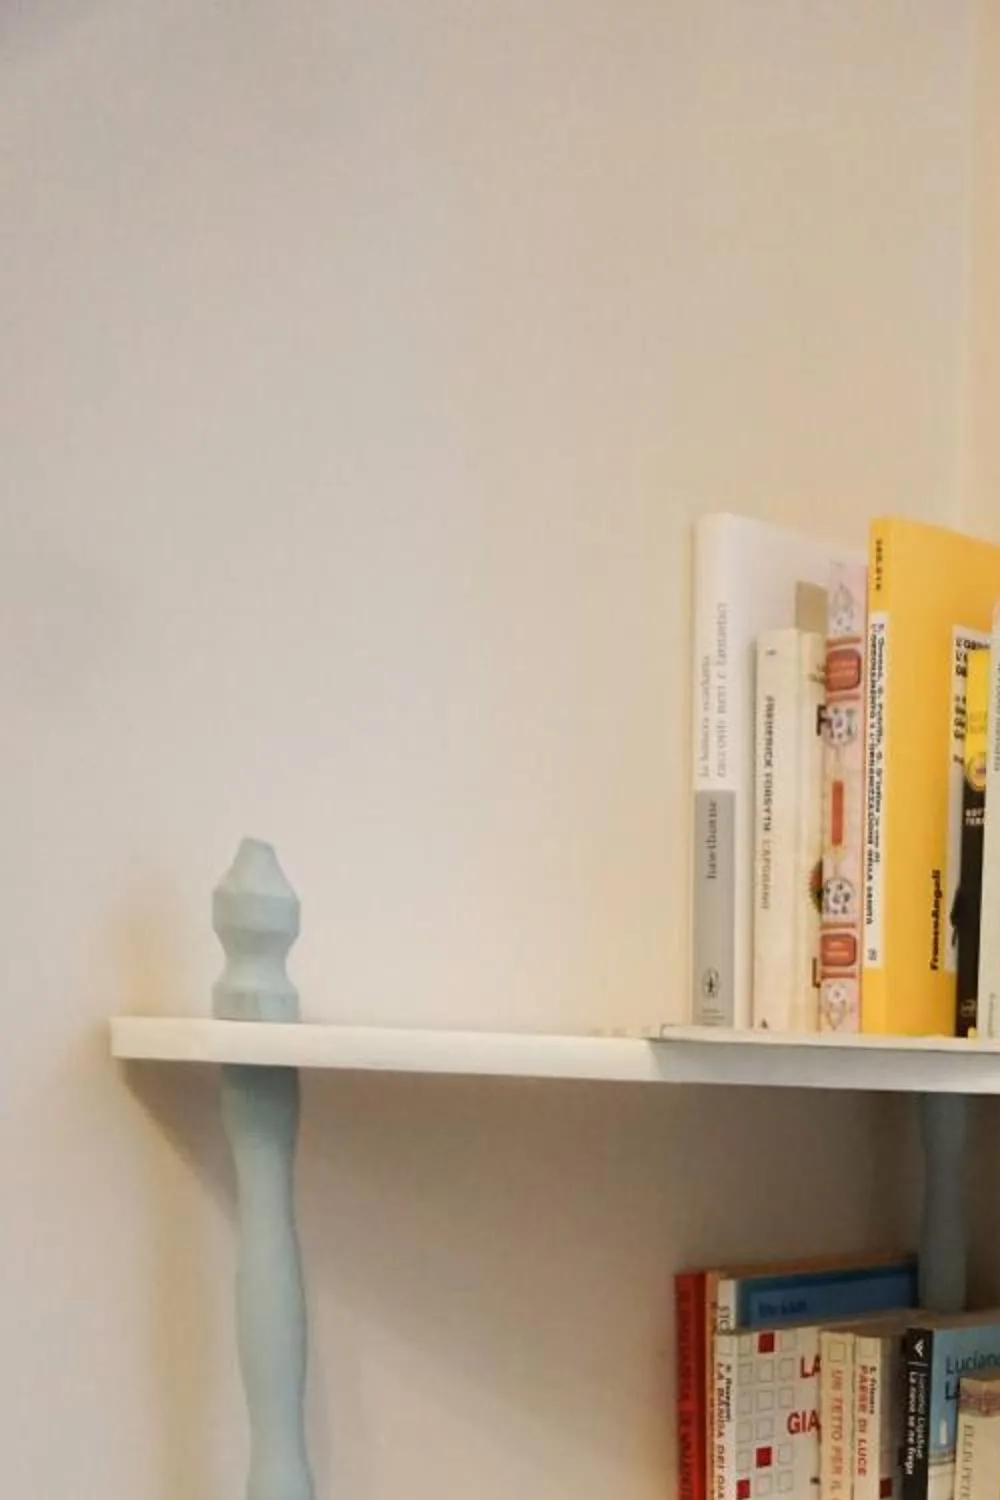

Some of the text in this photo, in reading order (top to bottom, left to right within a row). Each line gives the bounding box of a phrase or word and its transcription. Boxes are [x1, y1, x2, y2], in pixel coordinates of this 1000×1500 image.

[762, 772, 774, 832] FORSYTH
[787, 1409, 821, 1435] GIA
[830, 1397, 844, 1442] TETTO
[857, 1418, 868, 1433] DI
[830, 1446, 843, 1475] PER
[857, 1438, 868, 1477] LUCE
[830, 1480, 843, 1491] IL
